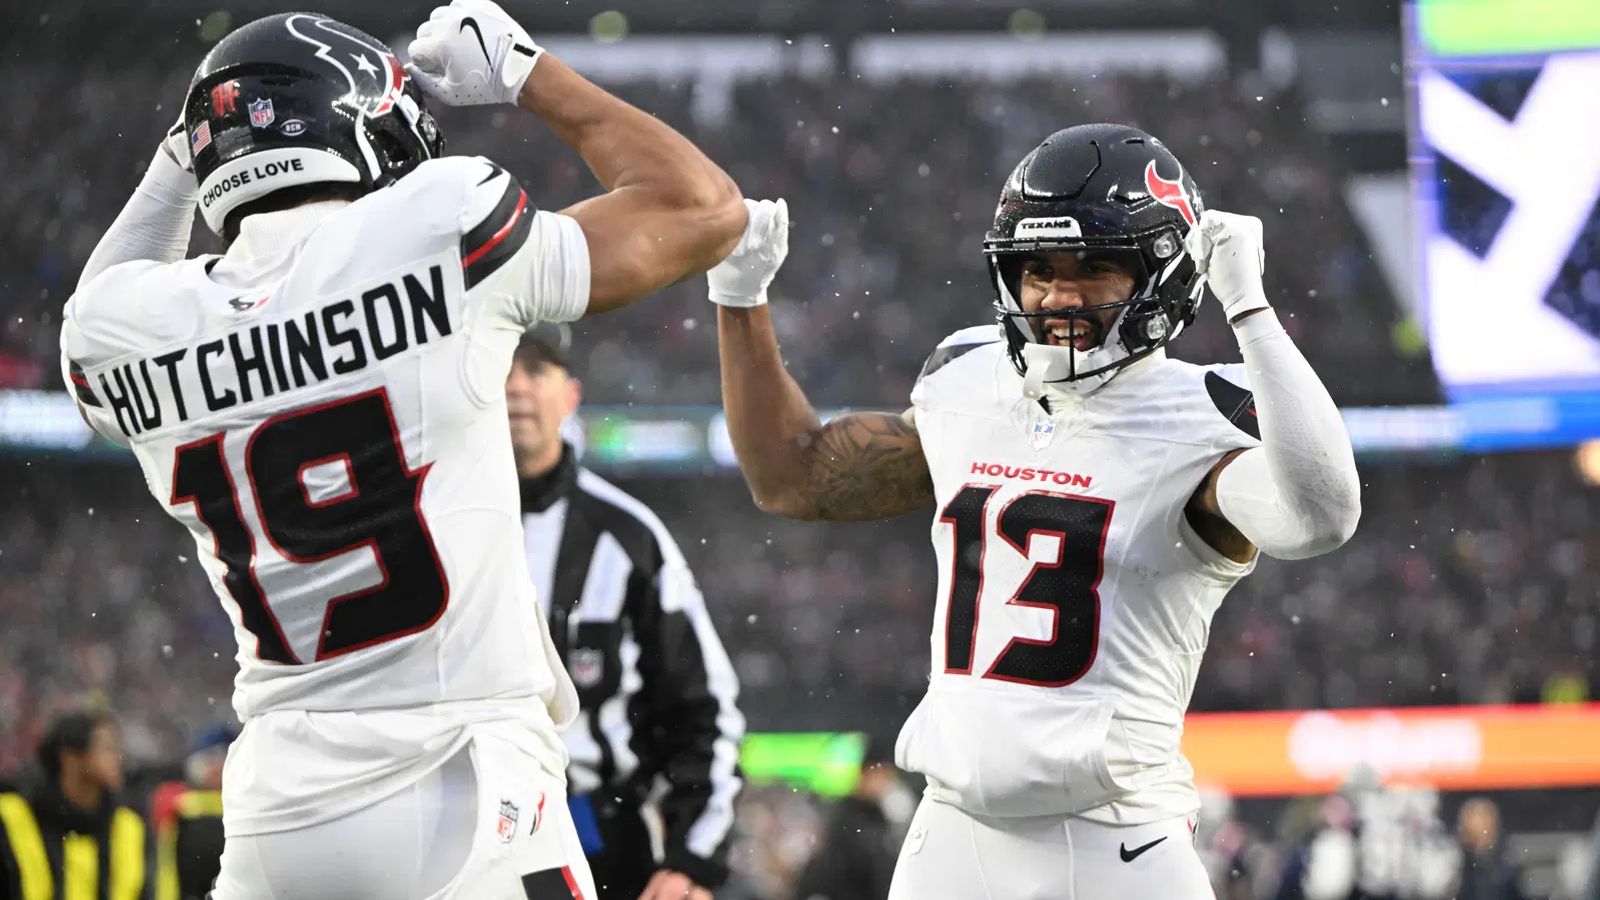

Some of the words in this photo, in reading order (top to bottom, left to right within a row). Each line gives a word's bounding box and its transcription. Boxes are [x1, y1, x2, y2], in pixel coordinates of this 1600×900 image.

[251, 108, 272, 123] NFL
[203, 170, 251, 208] CHOOSE
[254, 158, 304, 180] LOVE
[1021, 219, 1072, 230] TEXANS
[98, 265, 452, 437] HUTCHINSON
[970, 462, 1093, 488] HOUSTON
[170, 386, 450, 665] 19
[940, 482, 1116, 688] 13
